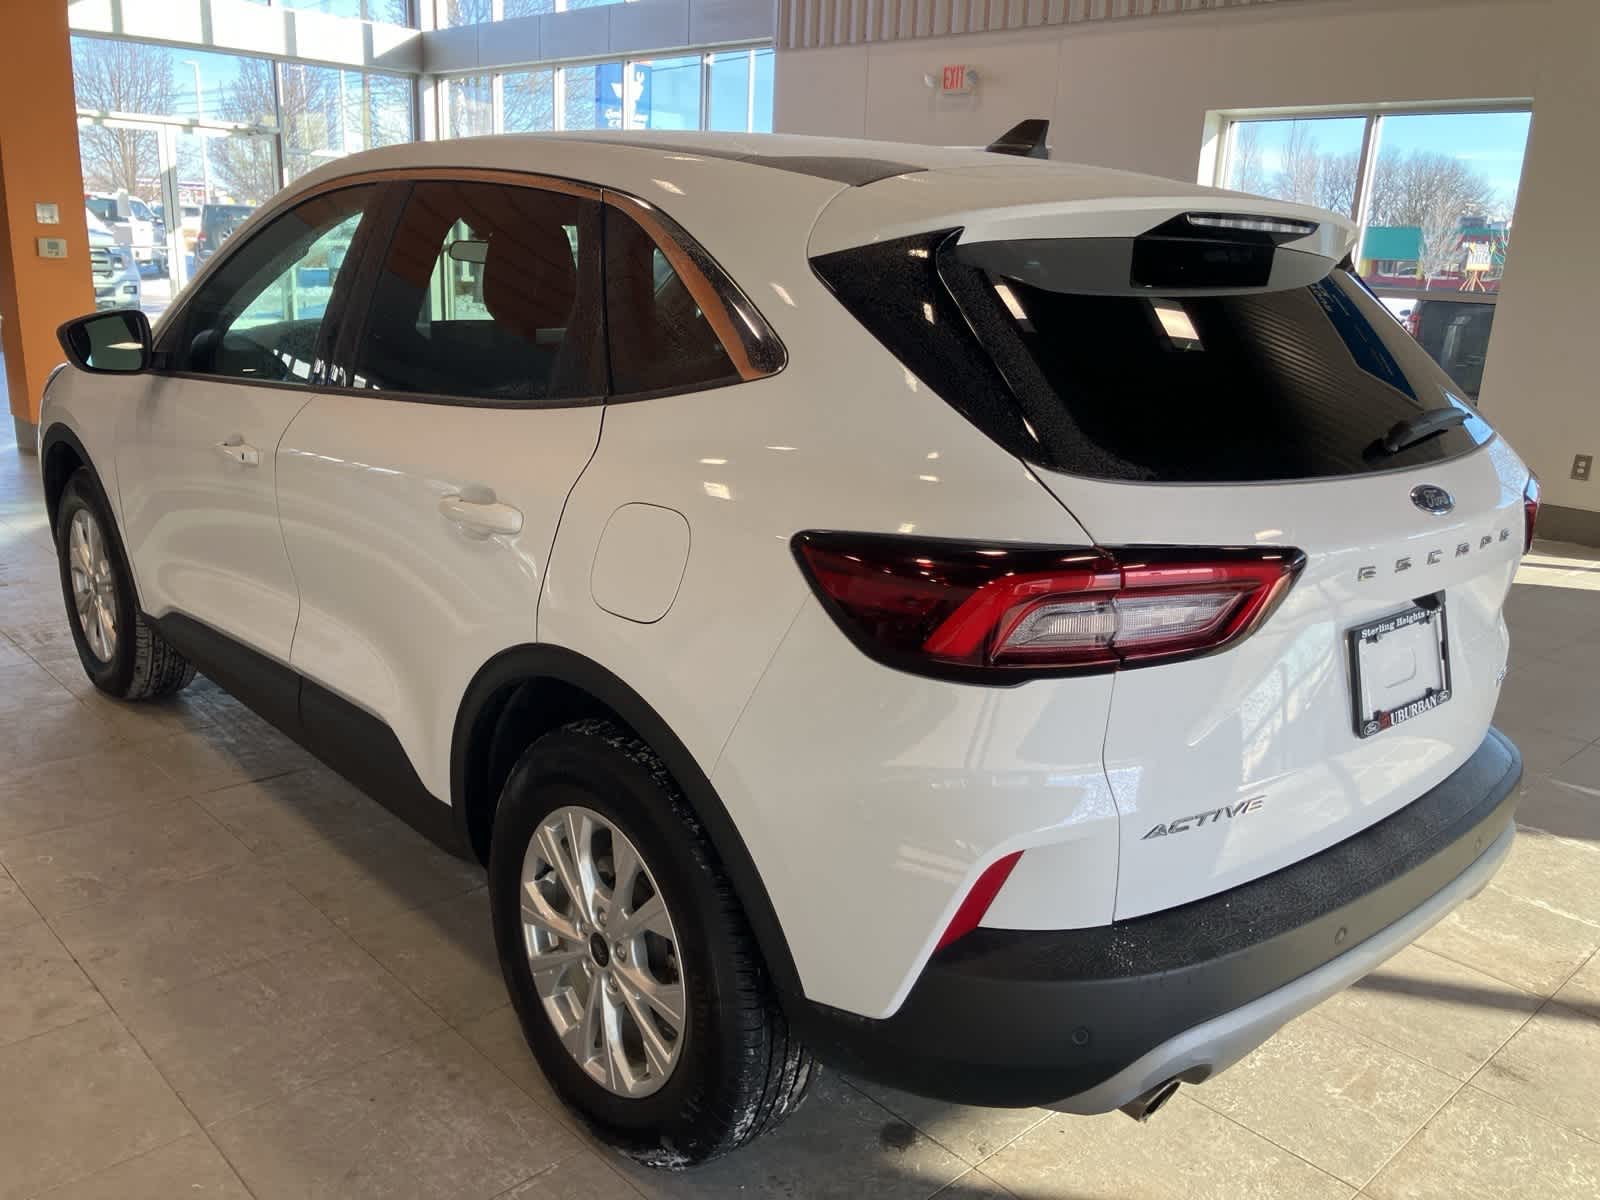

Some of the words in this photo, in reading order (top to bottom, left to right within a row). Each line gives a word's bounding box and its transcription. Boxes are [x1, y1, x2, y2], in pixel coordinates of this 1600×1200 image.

[943, 64, 966, 89] EXIT
[1423, 488, 1451, 508] Ford
[1357, 528, 1511, 582] ESCAPE
[1361, 621, 1395, 639] Sterling
[1396, 611, 1425, 627] Heights
[1379, 694, 1439, 730] SUBURBAN
[1140, 795, 1267, 840] ACTIVE
